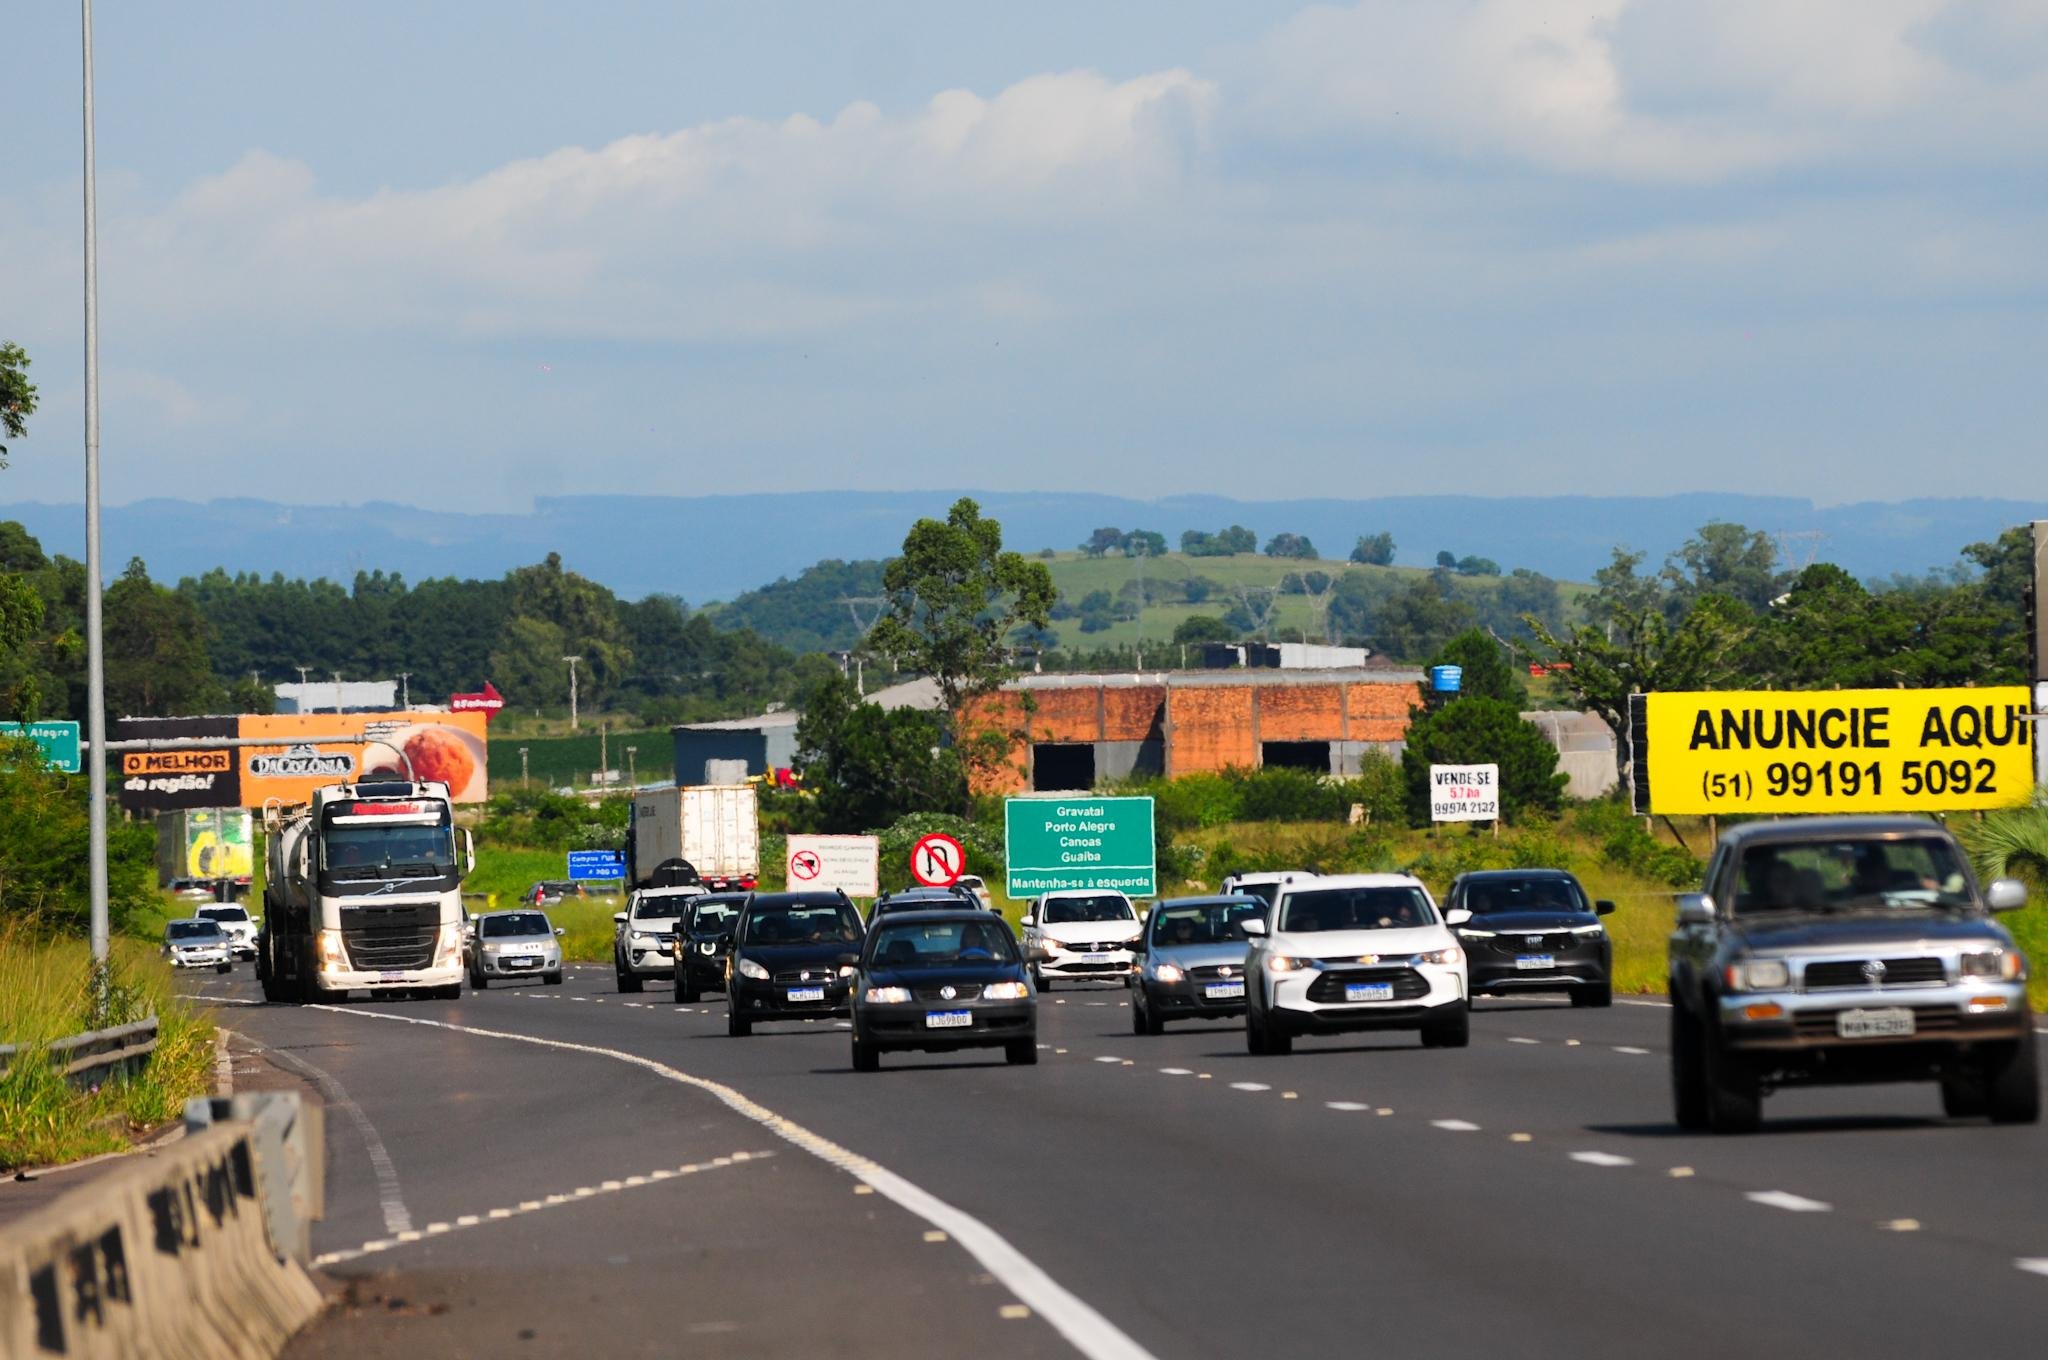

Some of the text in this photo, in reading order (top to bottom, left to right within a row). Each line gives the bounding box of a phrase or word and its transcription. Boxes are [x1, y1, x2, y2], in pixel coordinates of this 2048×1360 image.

[29, 728, 70, 739] Alegre
[1689, 704, 2028, 750] ANUNCIE AQUI
[128, 753, 226, 770] O MELHOR
[124, 774, 215, 794] da região!
[1435, 772, 1491, 785] VENDE-SE
[1702, 758, 1997, 801] (51) 99191 5092
[1434, 801, 1496, 815] 99974 2132
[1045, 821, 1116, 833] Porto Alegre
[1060, 836, 1102, 848] Canoas
[1012, 877, 1150, 889] Mantenha-se à esquerda
